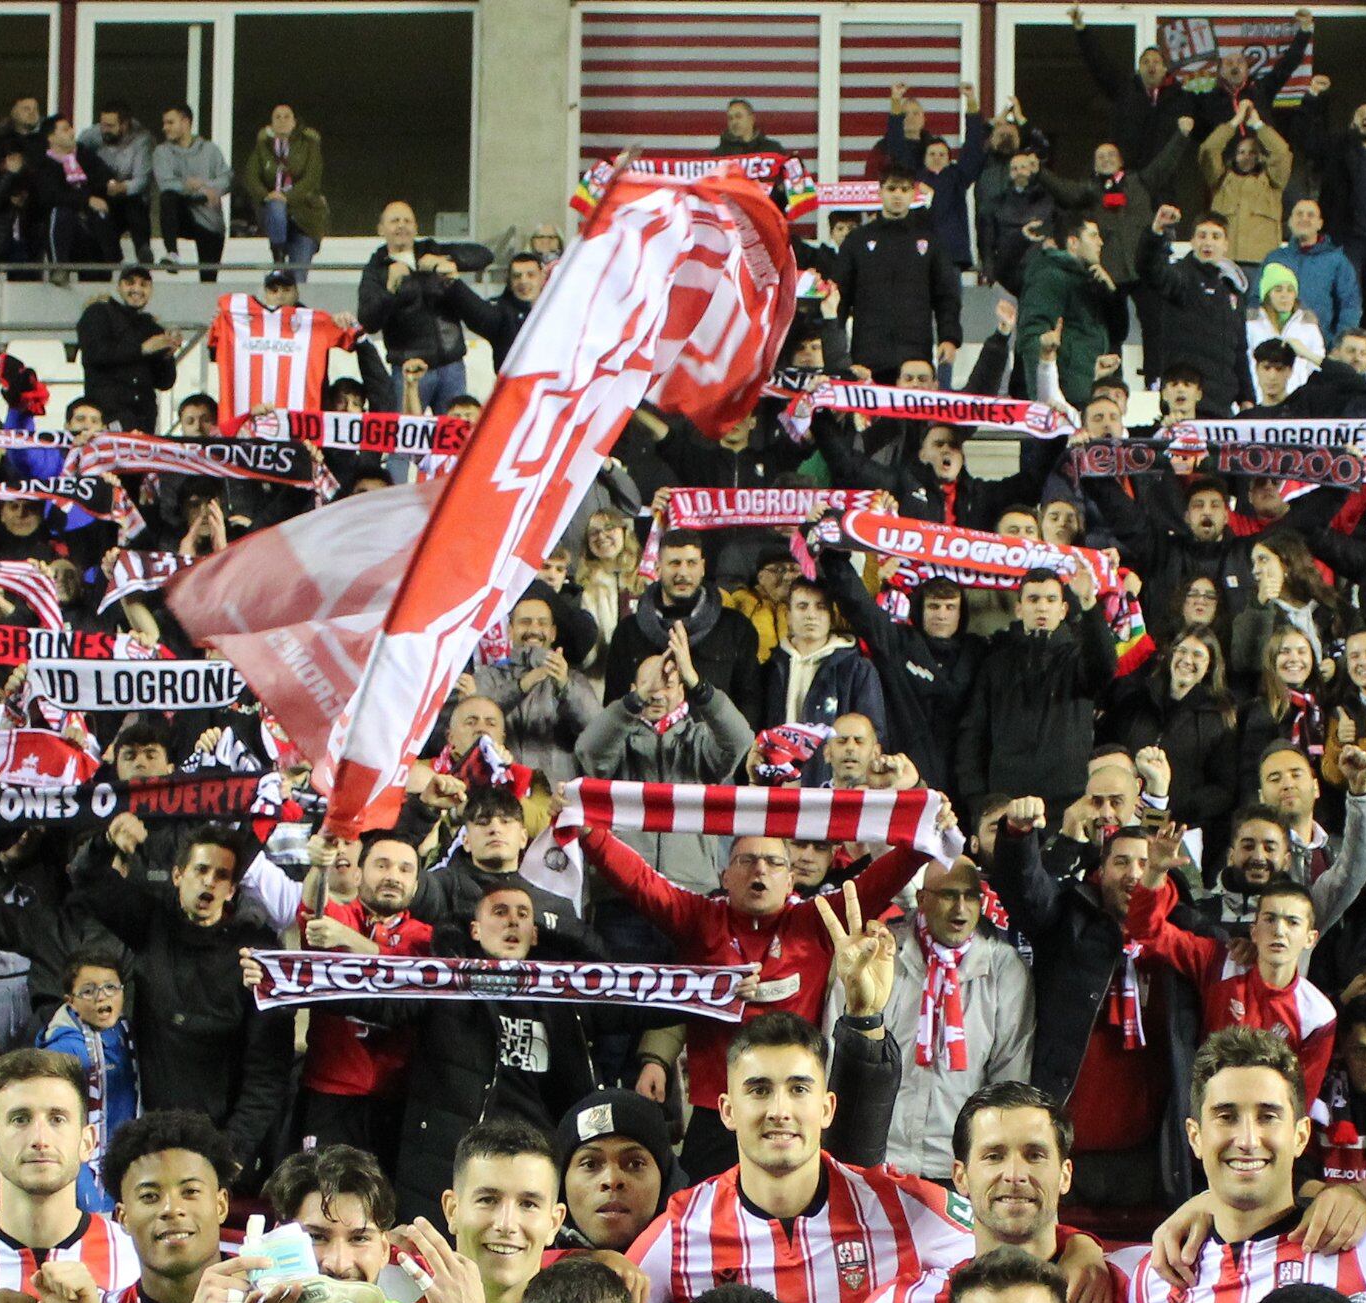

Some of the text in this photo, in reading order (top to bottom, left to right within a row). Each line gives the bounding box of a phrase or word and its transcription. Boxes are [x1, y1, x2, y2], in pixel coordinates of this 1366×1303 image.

[844, 384, 878, 411] UD
[290, 411, 322, 441] UD
[36, 668, 78, 704] UD
[91, 783, 117, 818] O
